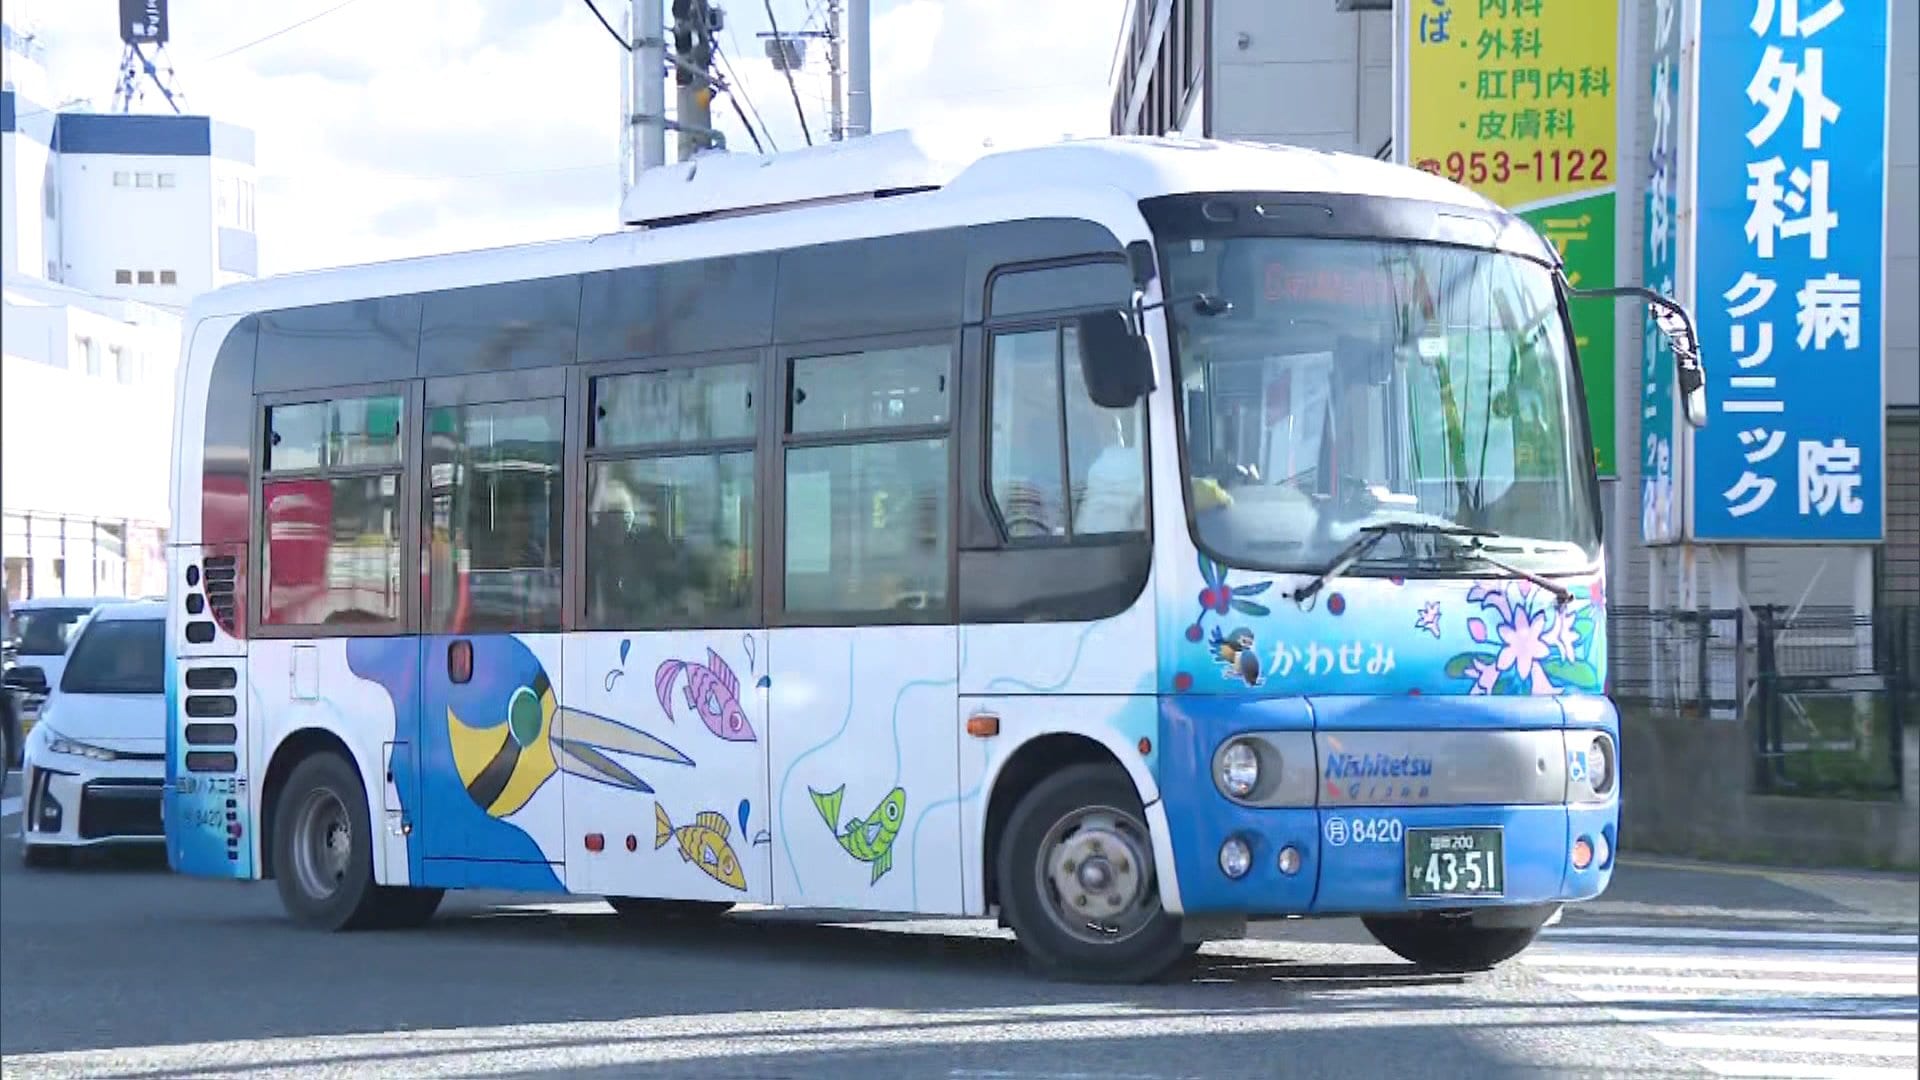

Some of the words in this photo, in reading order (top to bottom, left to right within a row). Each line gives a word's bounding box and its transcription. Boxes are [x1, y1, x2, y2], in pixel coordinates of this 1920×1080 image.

[1446, 149, 1608, 184] 953-1122
[1722, 271, 1786, 517] クリニック
[1796, 272, 1864, 517] 病院
[1269, 641, 1396, 677] かわせみ
[1324, 752, 1433, 780] Nishitetsu
[1351, 818, 1403, 842] 8420
[1425, 850, 1496, 891] 43-51
